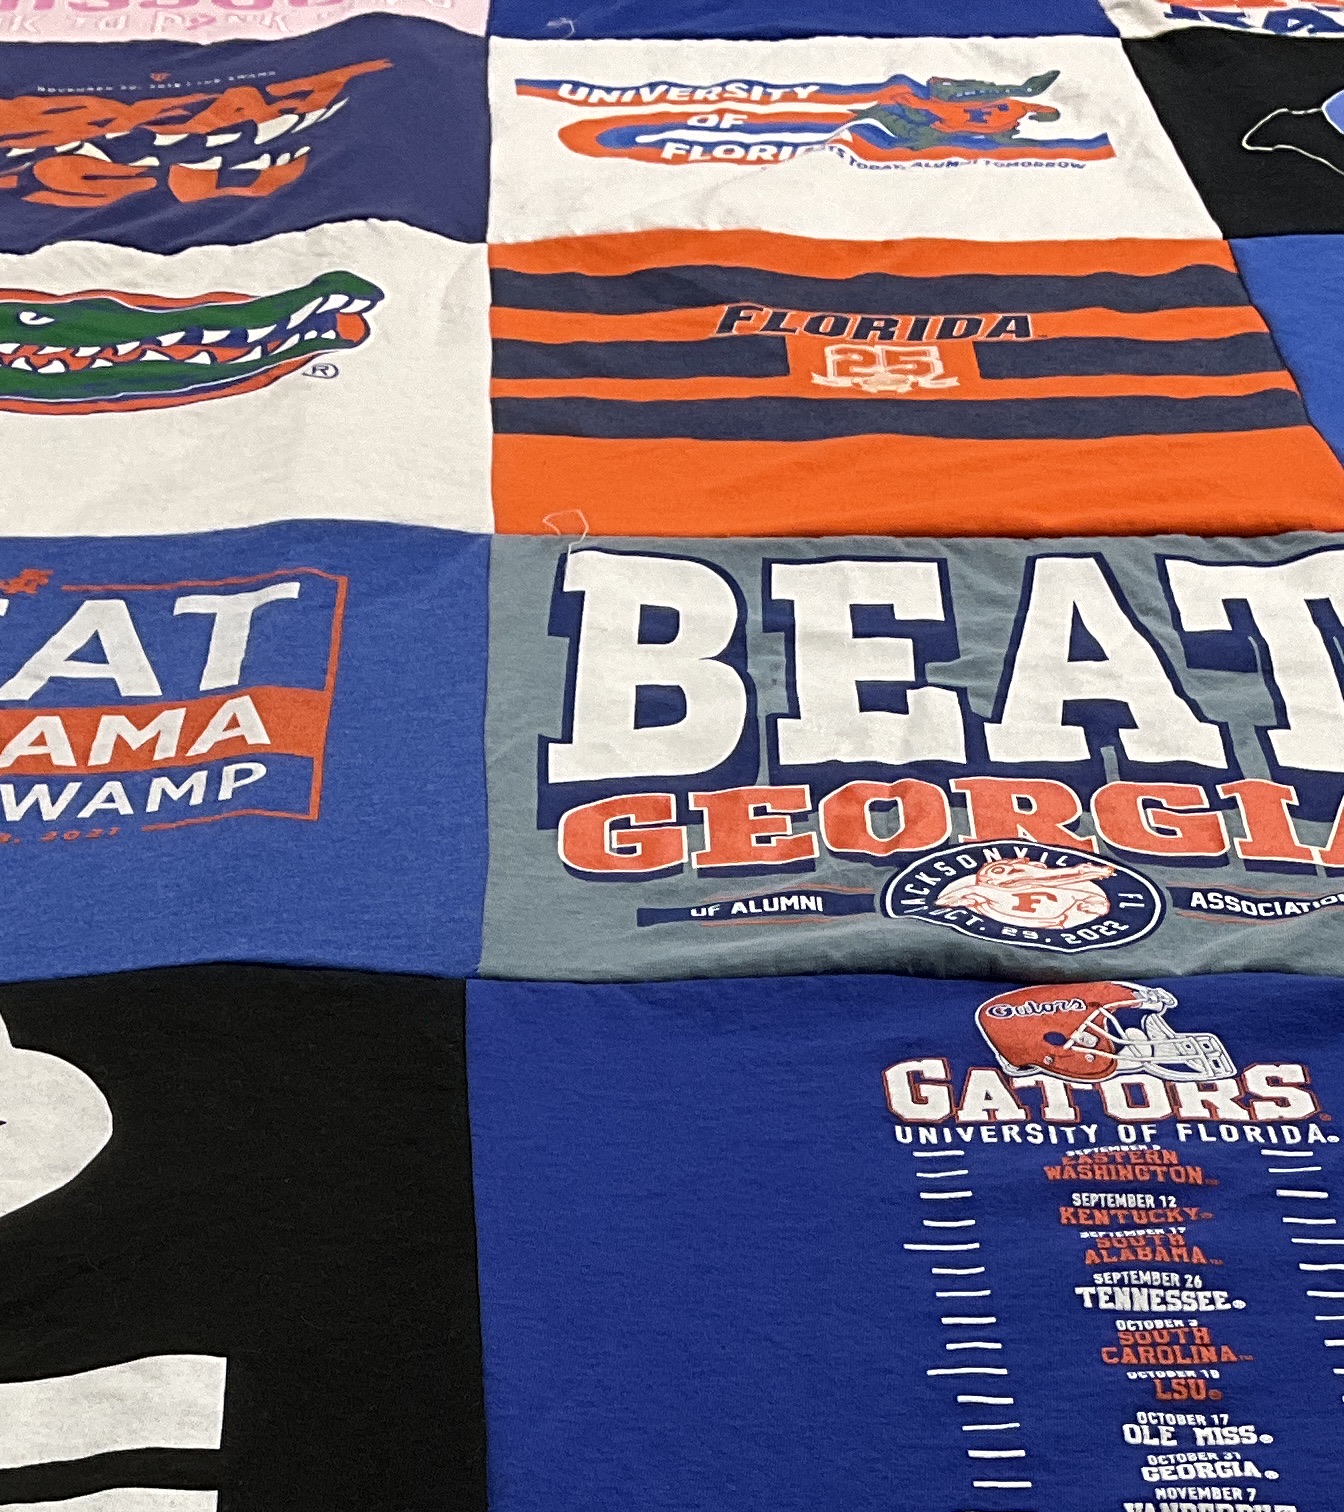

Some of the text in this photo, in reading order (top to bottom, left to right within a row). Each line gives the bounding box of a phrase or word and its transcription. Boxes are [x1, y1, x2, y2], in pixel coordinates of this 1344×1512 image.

[557, 81, 821, 105] UNIVERSITY
[686, 112, 751, 131] OF
[711, 302, 1038, 343] FLORIDA
[690, 894, 824, 917] UF ALUMNI
[1011, 891, 1058, 914] F
[1059, 919, 1130, 946] 2022
[986, 995, 1088, 1020] Gators
[881, 1056, 1321, 1124] GATORS
[894, 1122, 1099, 1146] UNIVERSITY
[1117, 1122, 1158, 1146] OF
[1061, 1149, 1180, 1166] EASTERN
[1043, 1163, 1205, 1185] WASHINGTON
[1071, 1192, 1178, 1209] SEPTEMBER 12
[1058, 1206, 1200, 1226] KENTUCKY
[1095, 1233, 1186, 1249] SOUTH
[1084, 1245, 1207, 1266] ALABAMA
[1092, 1269, 1203, 1289] SEPTEMBER 26
[1114, 1318, 1185, 1331] OCTOBER
[1116, 1326, 1212, 1346] SOUTH
[1100, 1344, 1238, 1366] CAROLINA
[1152, 1377, 1208, 1401] LSU
[1135, 1410, 1230, 1427] OCTOBER 17
[1121, 1422, 1178, 1447] OLE
[1146, 1450, 1242, 1467] OCTOBER 31
[1140, 1459, 1263, 1483] GEORGIA
[1154, 1486, 1257, 1502] NOVEMBER 7
